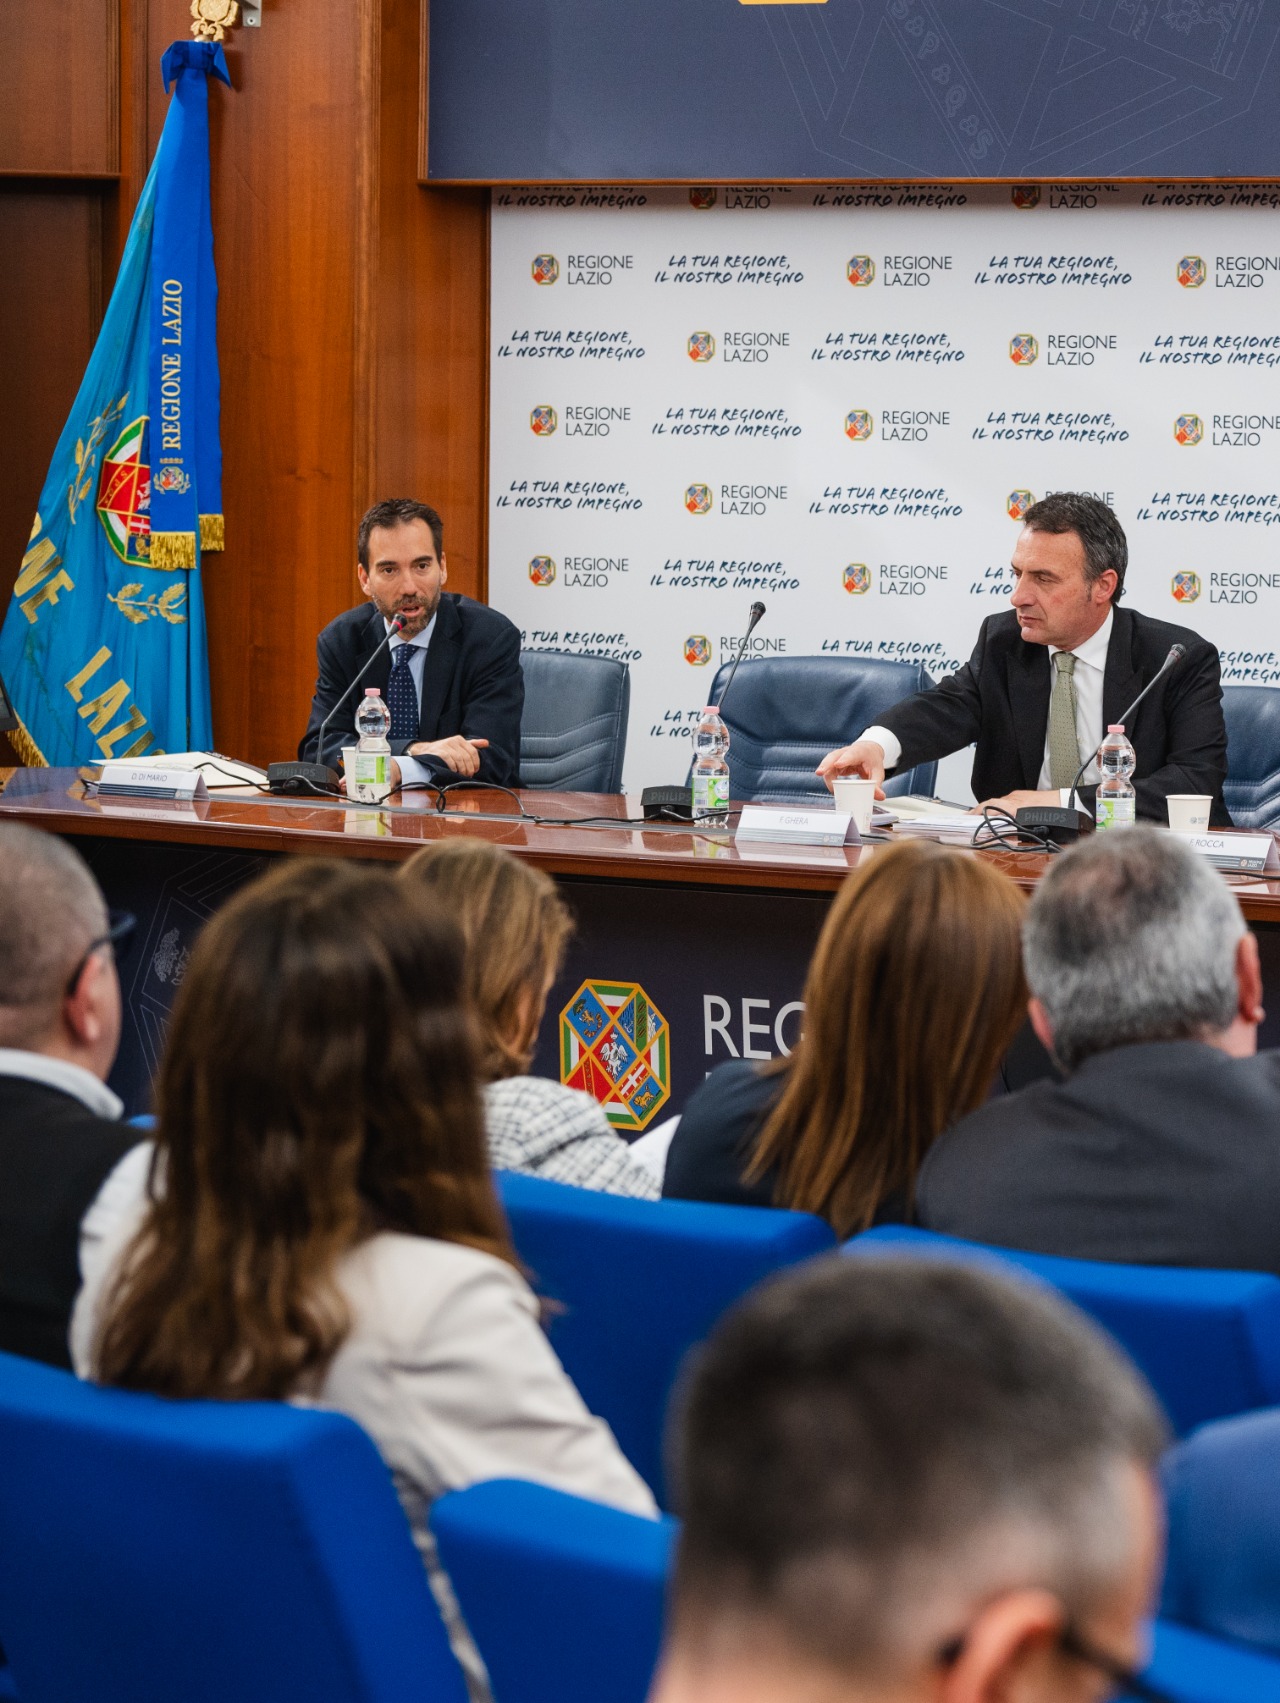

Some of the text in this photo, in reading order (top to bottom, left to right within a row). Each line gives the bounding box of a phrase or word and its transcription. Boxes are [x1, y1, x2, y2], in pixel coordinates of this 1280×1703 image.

[1141, 193, 1159, 207] IL
[1161, 192, 1226, 208] NOSTRO
[567, 254, 634, 269] REGIONE
[668, 254, 791, 271] LA TUA REGIONE,
[884, 255, 953, 270] REGIONE
[567, 271, 613, 286] LAZIO
[654, 271, 804, 287] IL NOSTRO IMPEGNO
[883, 272, 931, 287] LAZIO
[1215, 273, 1264, 288] LAZIO
[723, 331, 790, 347] REGIONE
[825, 332, 951, 349] LA TUA REGIONE,
[1047, 334, 1118, 350] REGIONE
[723, 348, 769, 363] LAZIO
[811, 348, 965, 365] IL NOSTRO IMPEGNO
[1047, 351, 1095, 366] LAZIO
[160, 279, 183, 450] REGIONE LAZIO
[565, 406, 631, 421] REGIONE
[882, 410, 951, 426] REGIONE
[565, 422, 611, 437] LAZIO
[881, 427, 929, 442] LAZIO
[1212, 431, 1261, 447] LAZIO
[509, 480, 629, 497] LA TUA REGIONE,
[721, 484, 788, 500] REGIONE
[496, 495, 643, 513] IL NOSTRO IMPEGNO
[720, 501, 767, 516] LAZIO
[564, 556, 629, 572] REGIONE
[879, 564, 948, 580] REGIONE
[564, 573, 609, 588] LAZIO
[1210, 572, 1280, 588] REGIONE
[879, 581, 926, 596] LAZIO
[1209, 589, 1258, 605] LAZIO
[531, 630, 630, 648] TUA REGIONE,
[720, 636, 787, 652] REGIONE
[821, 639, 946, 658] LA TUA REGIONE,
[1218, 650, 1279, 669] EGIONE,
[64, 645, 166, 760] LAZI
[138, 773, 146, 781] DI
[147, 773, 168, 783] MARIO
[276, 767, 316, 777] PHILIPS
[785, 816, 809, 825] GHERA
[1023, 812, 1068, 823] PHILIPS
[1194, 839, 1224, 849] ROCCA
